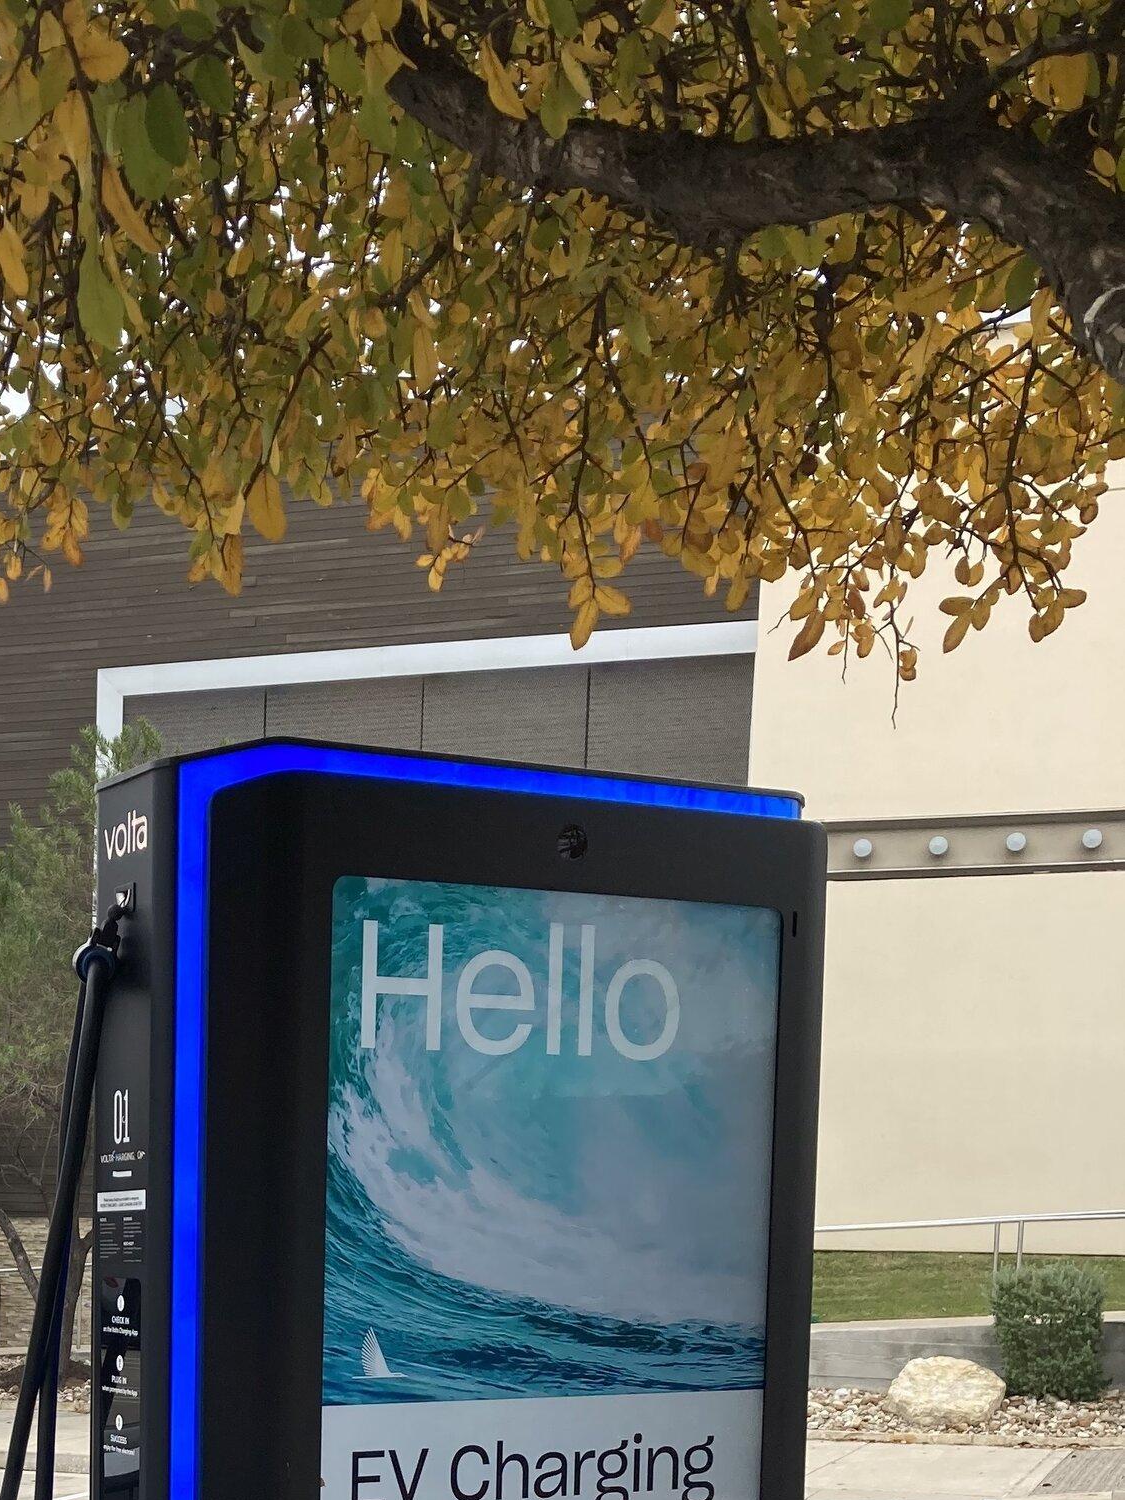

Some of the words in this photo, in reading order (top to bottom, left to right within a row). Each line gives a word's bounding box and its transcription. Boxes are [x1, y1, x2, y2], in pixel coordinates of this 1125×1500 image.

[104, 809, 148, 860] volta
[360, 919, 681, 1062] Hello
[113, 1088, 131, 1145] 01
[111, 1315, 125, 1325] CHECK
[125, 1316, 130, 1325] IN
[111, 1374, 122, 1384] PLUG
[122, 1376, 127, 1385] IN
